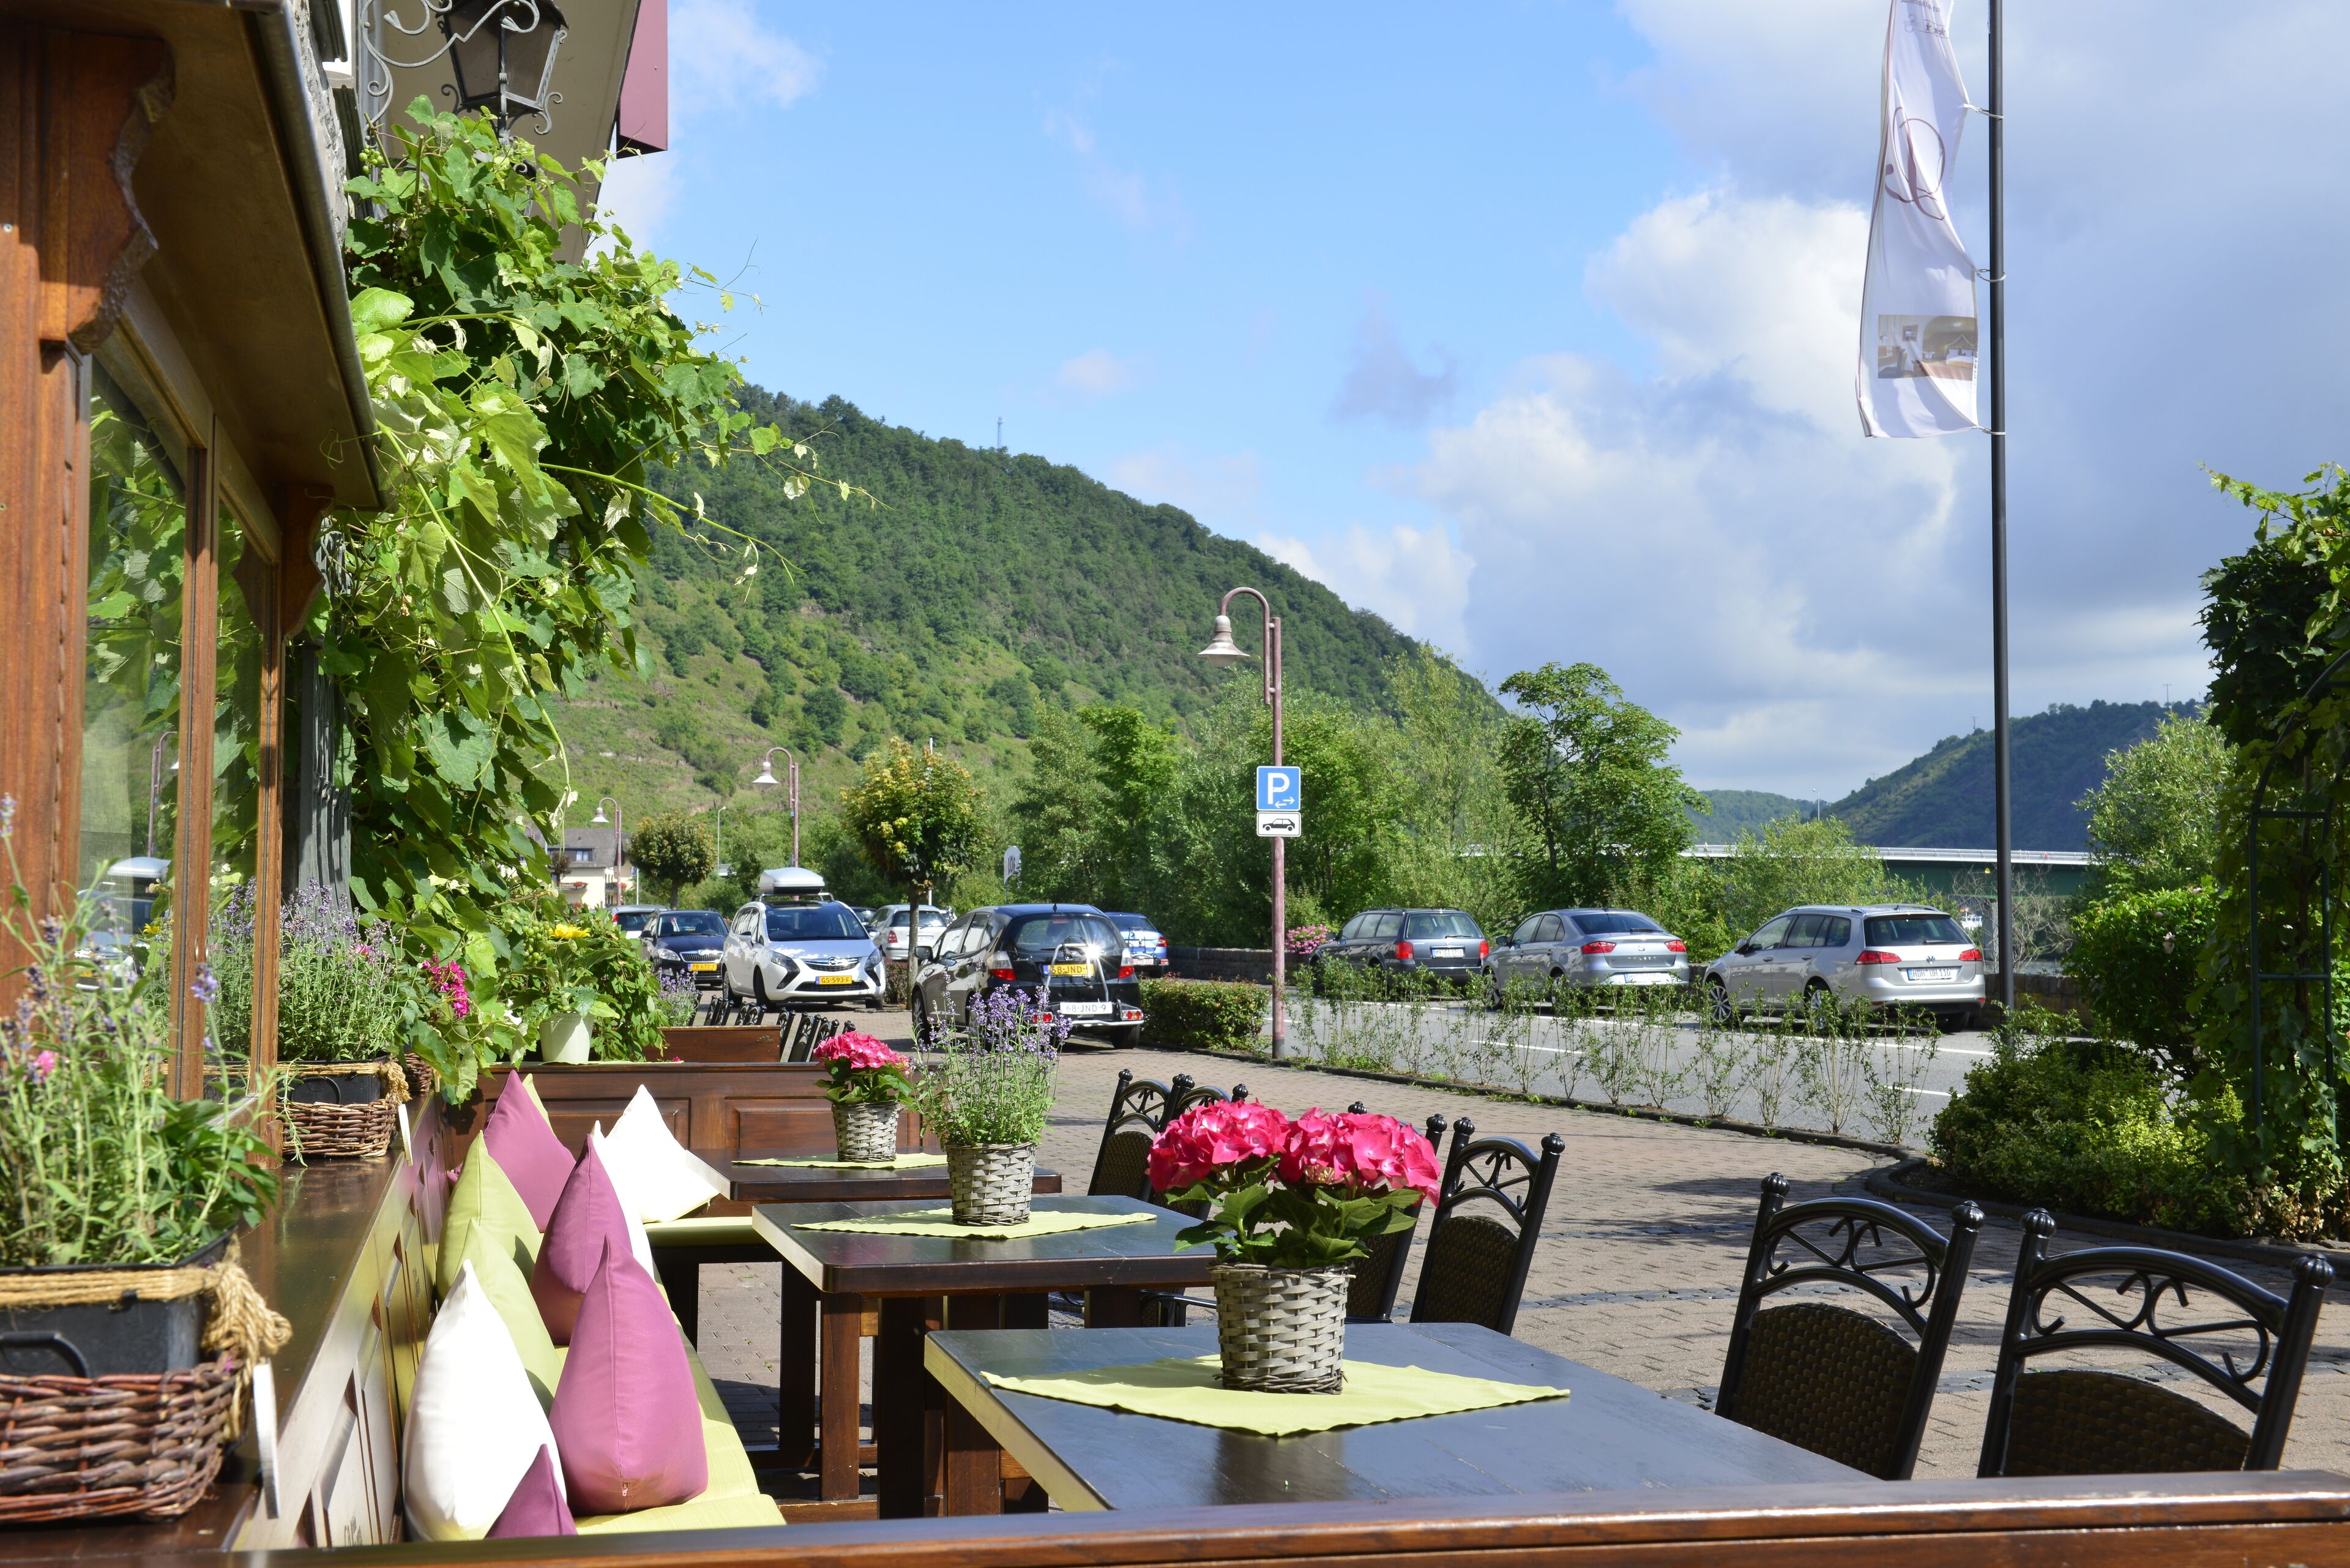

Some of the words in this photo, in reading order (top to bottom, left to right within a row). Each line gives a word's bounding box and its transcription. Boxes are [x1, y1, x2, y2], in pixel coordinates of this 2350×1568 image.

[1268, 772, 1290, 805] P
[1051, 965, 1092, 974] 68-JND-
[1066, 1004, 1106, 1012] 68-JND-9
